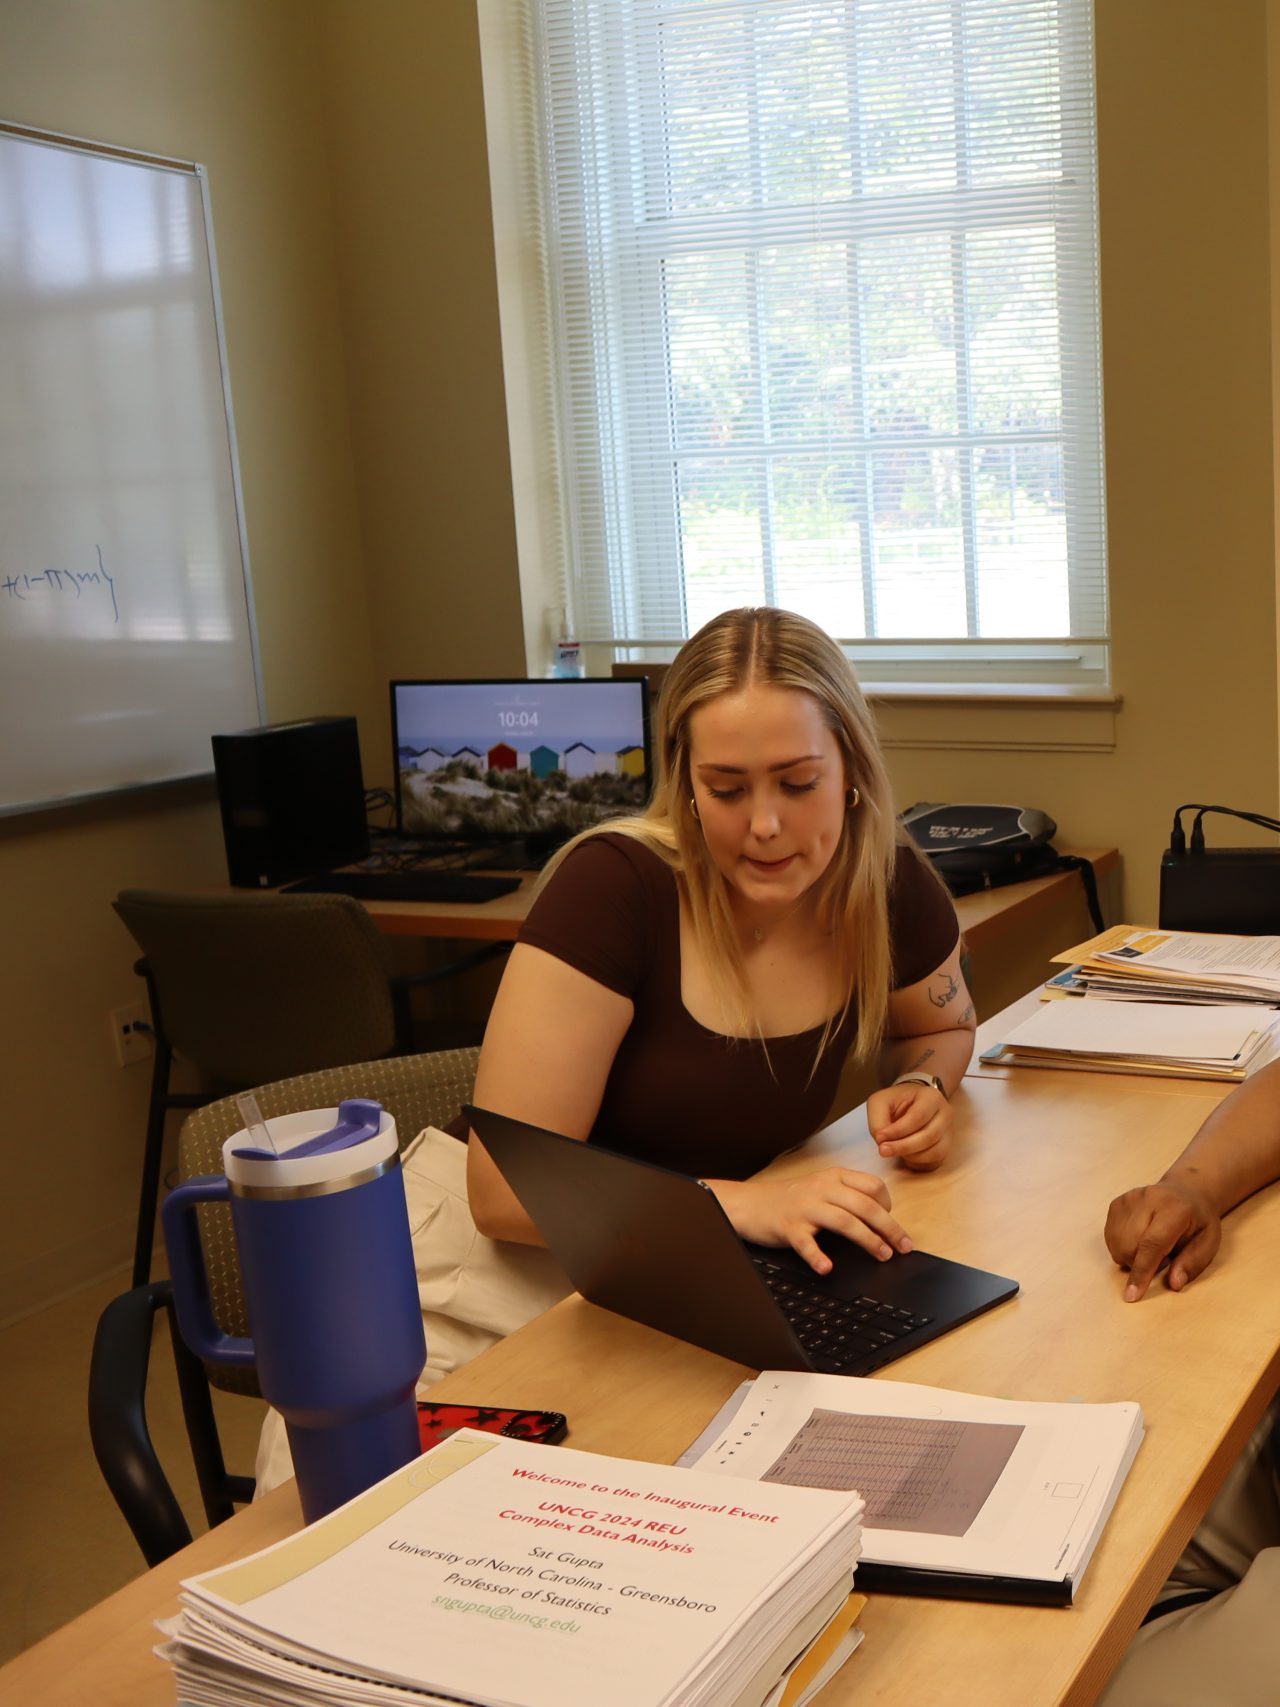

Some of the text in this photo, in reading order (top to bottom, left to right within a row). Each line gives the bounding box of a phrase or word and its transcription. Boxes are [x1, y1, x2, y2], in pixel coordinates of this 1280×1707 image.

[497, 711, 539, 728] 10:04
[512, 1468, 780, 1524] Welcome to the Inaugural Event
[498, 1509, 696, 1555] Complex Data Analysis
[537, 1501, 688, 1536] UNCG 2024 REU
[388, 1539, 464, 1565] University
[465, 1557, 487, 1568] of
[484, 1558, 534, 1577] North
[538, 1569, 604, 1591] Carolina
[619, 1585, 717, 1613] Greensboro
[528, 1546, 605, 1570] Sat Gupta
[431, 1595, 583, 1634] sngupta@uncg.edu
[443, 1572, 613, 1616] Professor of Statistics
